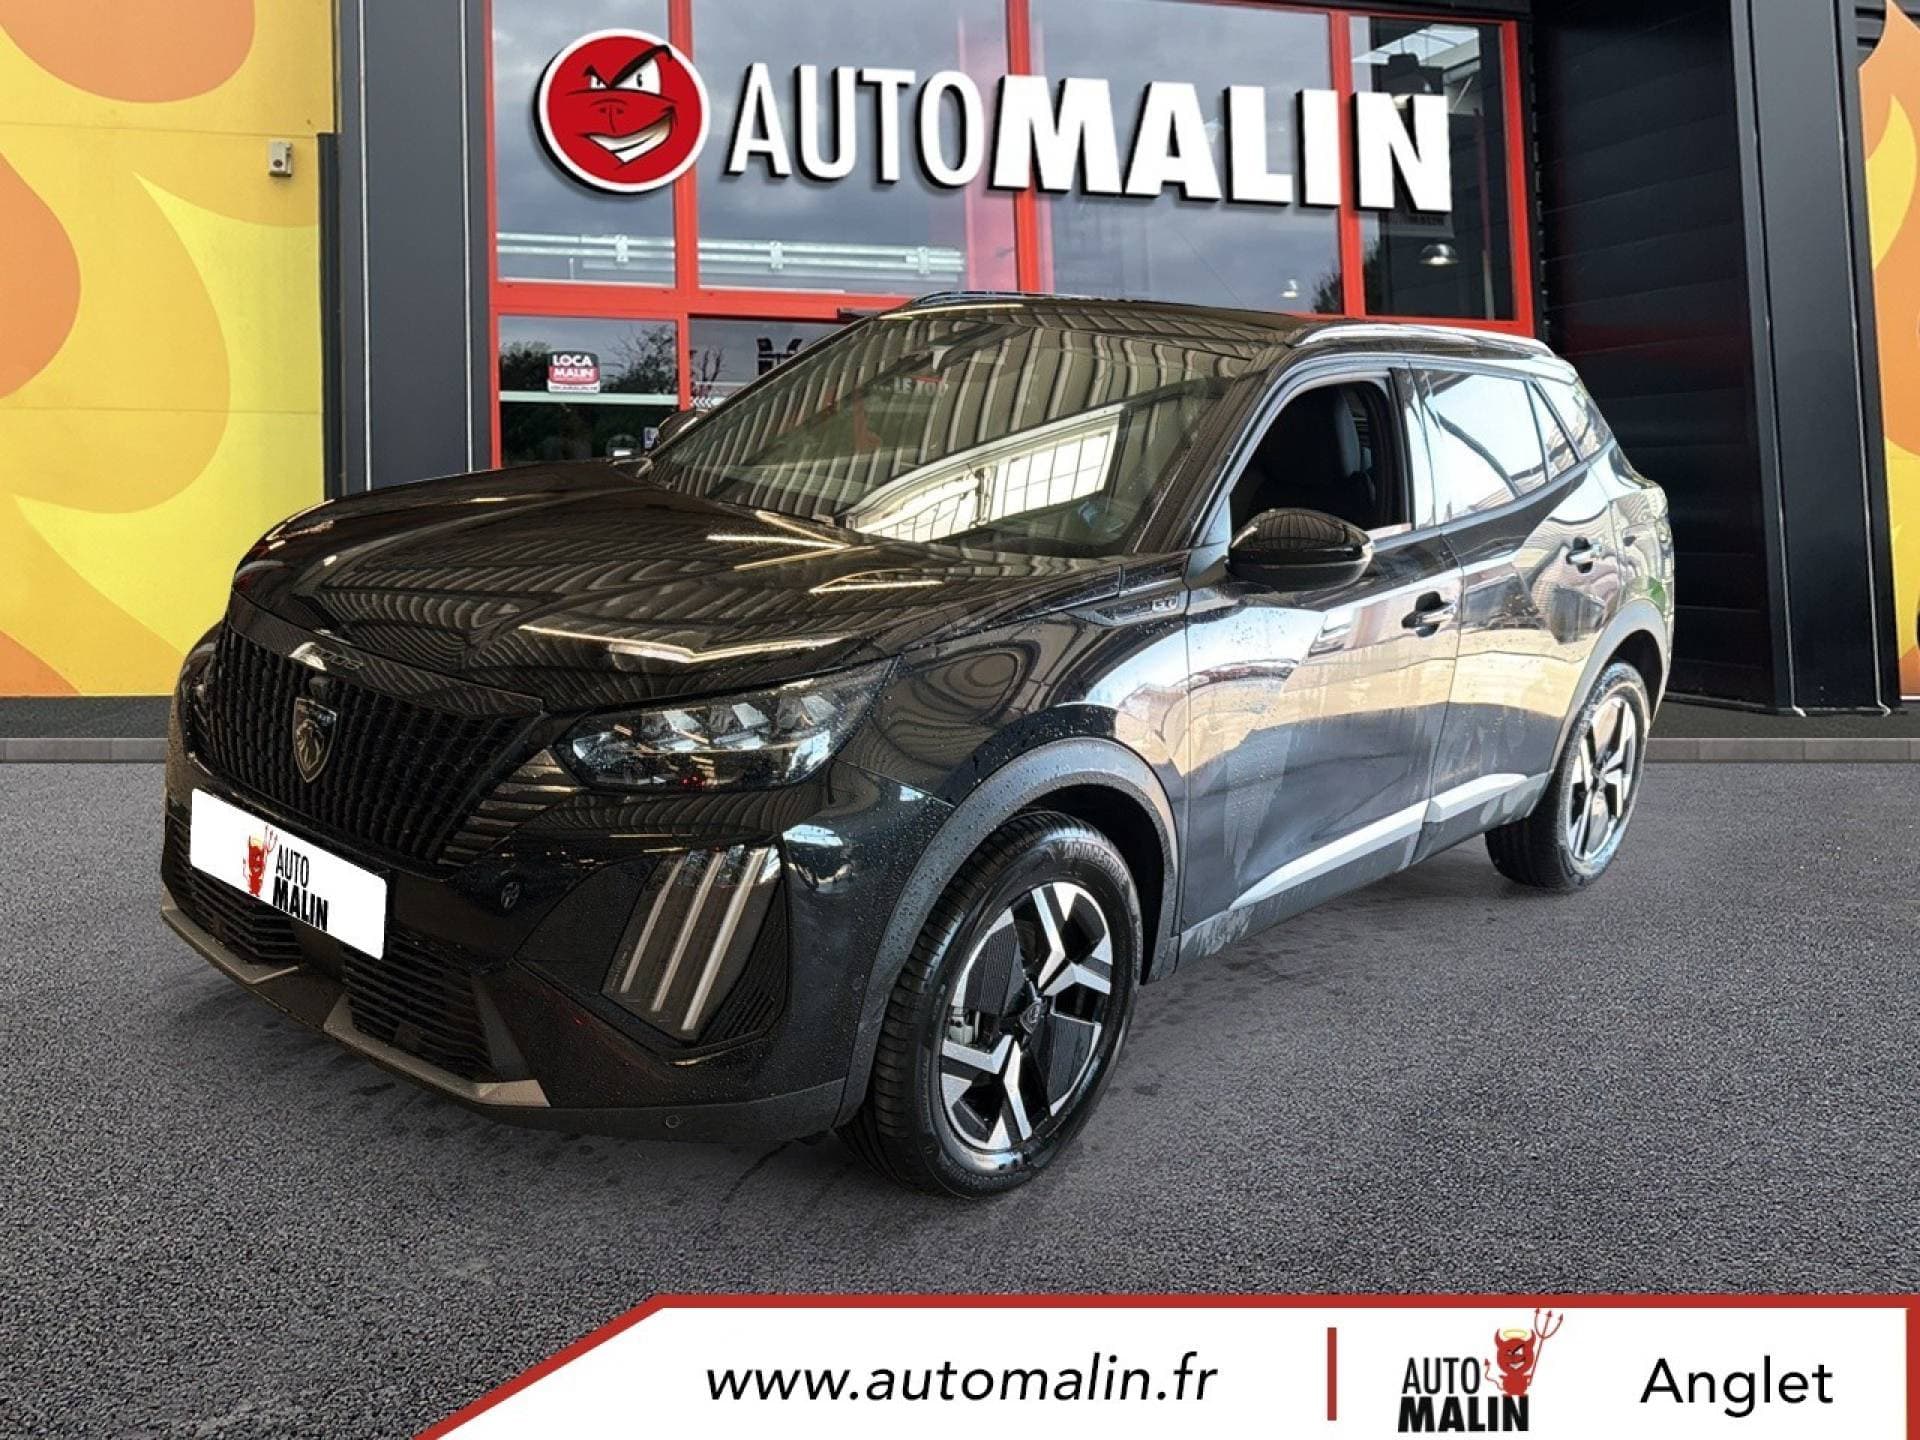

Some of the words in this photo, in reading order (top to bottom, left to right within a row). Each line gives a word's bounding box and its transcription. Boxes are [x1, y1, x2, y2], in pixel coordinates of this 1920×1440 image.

[730, 62, 1451, 212] AUTOMALIN
[552, 353, 593, 367] LOCA
[554, 367, 594, 379] MALIN
[275, 844, 310, 889] AUTO
[272, 875, 328, 931] MALIN
